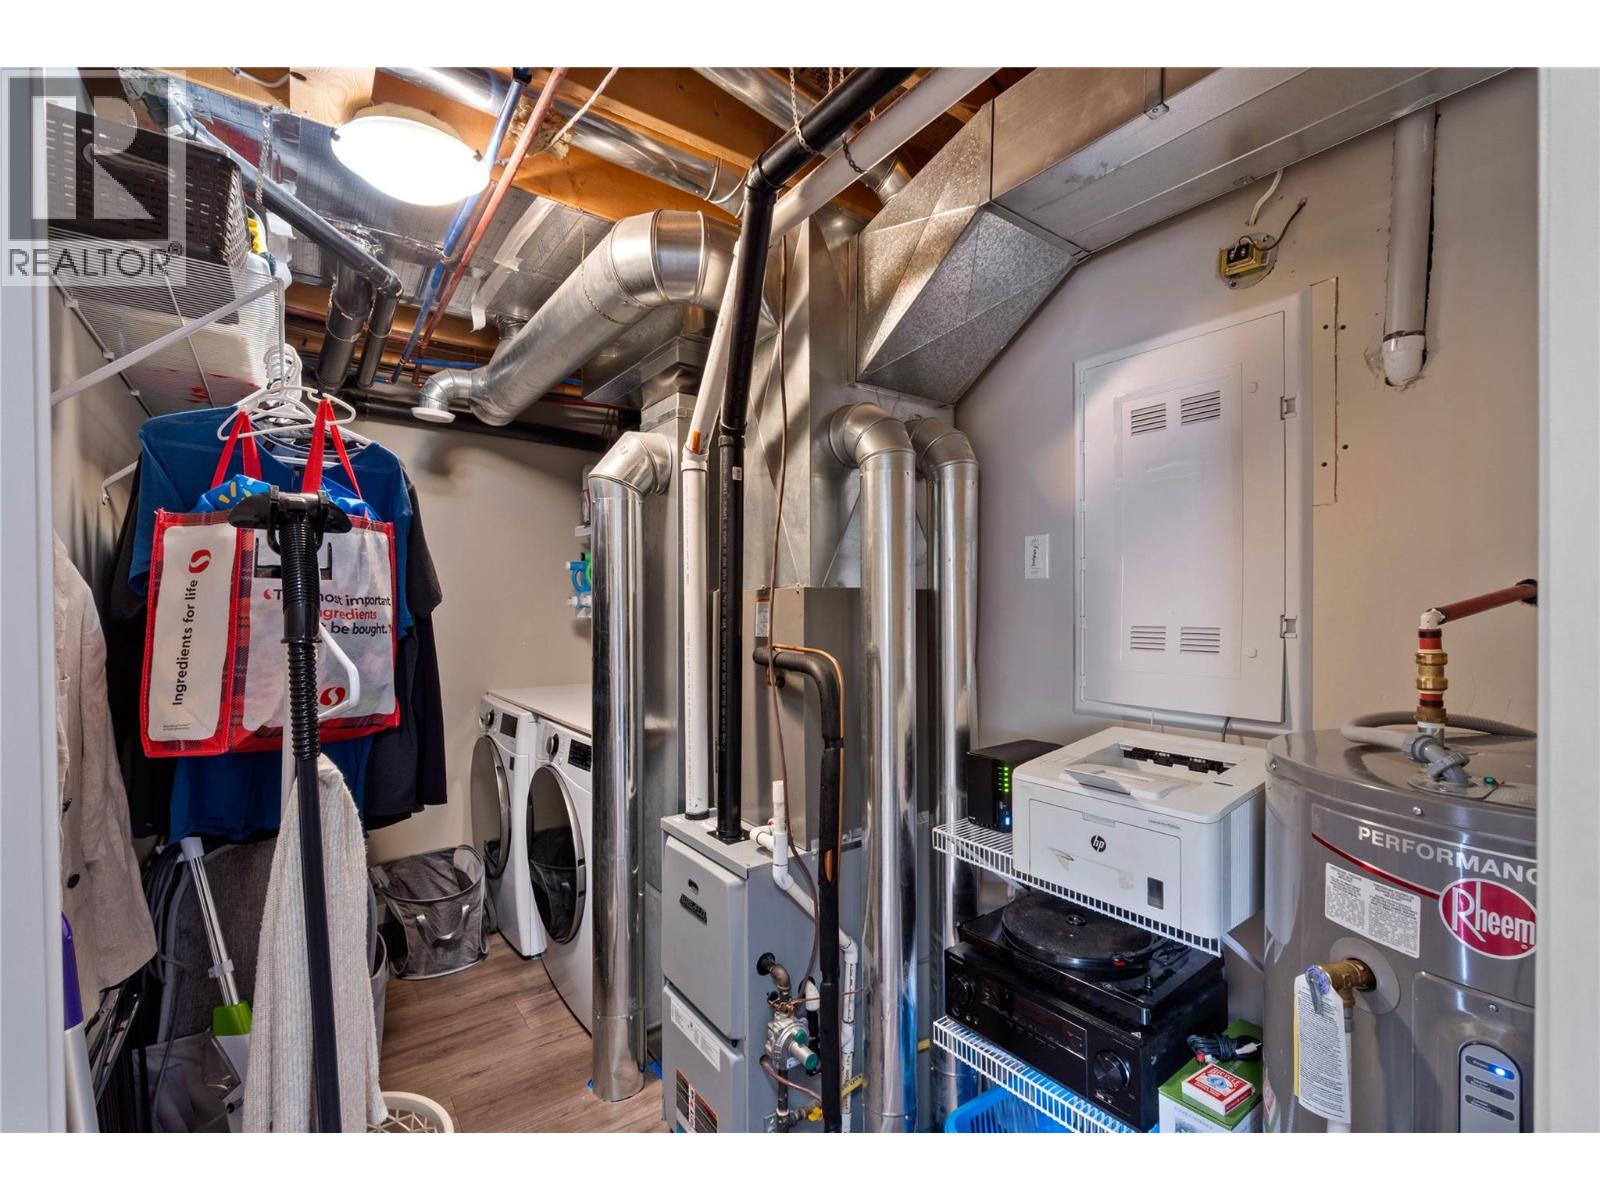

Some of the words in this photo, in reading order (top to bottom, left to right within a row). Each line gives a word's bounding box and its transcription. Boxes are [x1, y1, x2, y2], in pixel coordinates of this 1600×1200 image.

[184, 579, 198, 600] life
[345, 594, 391, 607] important
[183, 604, 196, 623] for
[319, 608, 377, 621] gredients
[331, 621, 350, 634] be
[172, 627, 193, 706] Ingredients
[1091, 835, 1107, 853] hp
[1358, 826, 1537, 886] PERFORMANC
[1452, 880, 1536, 946] Rheem
